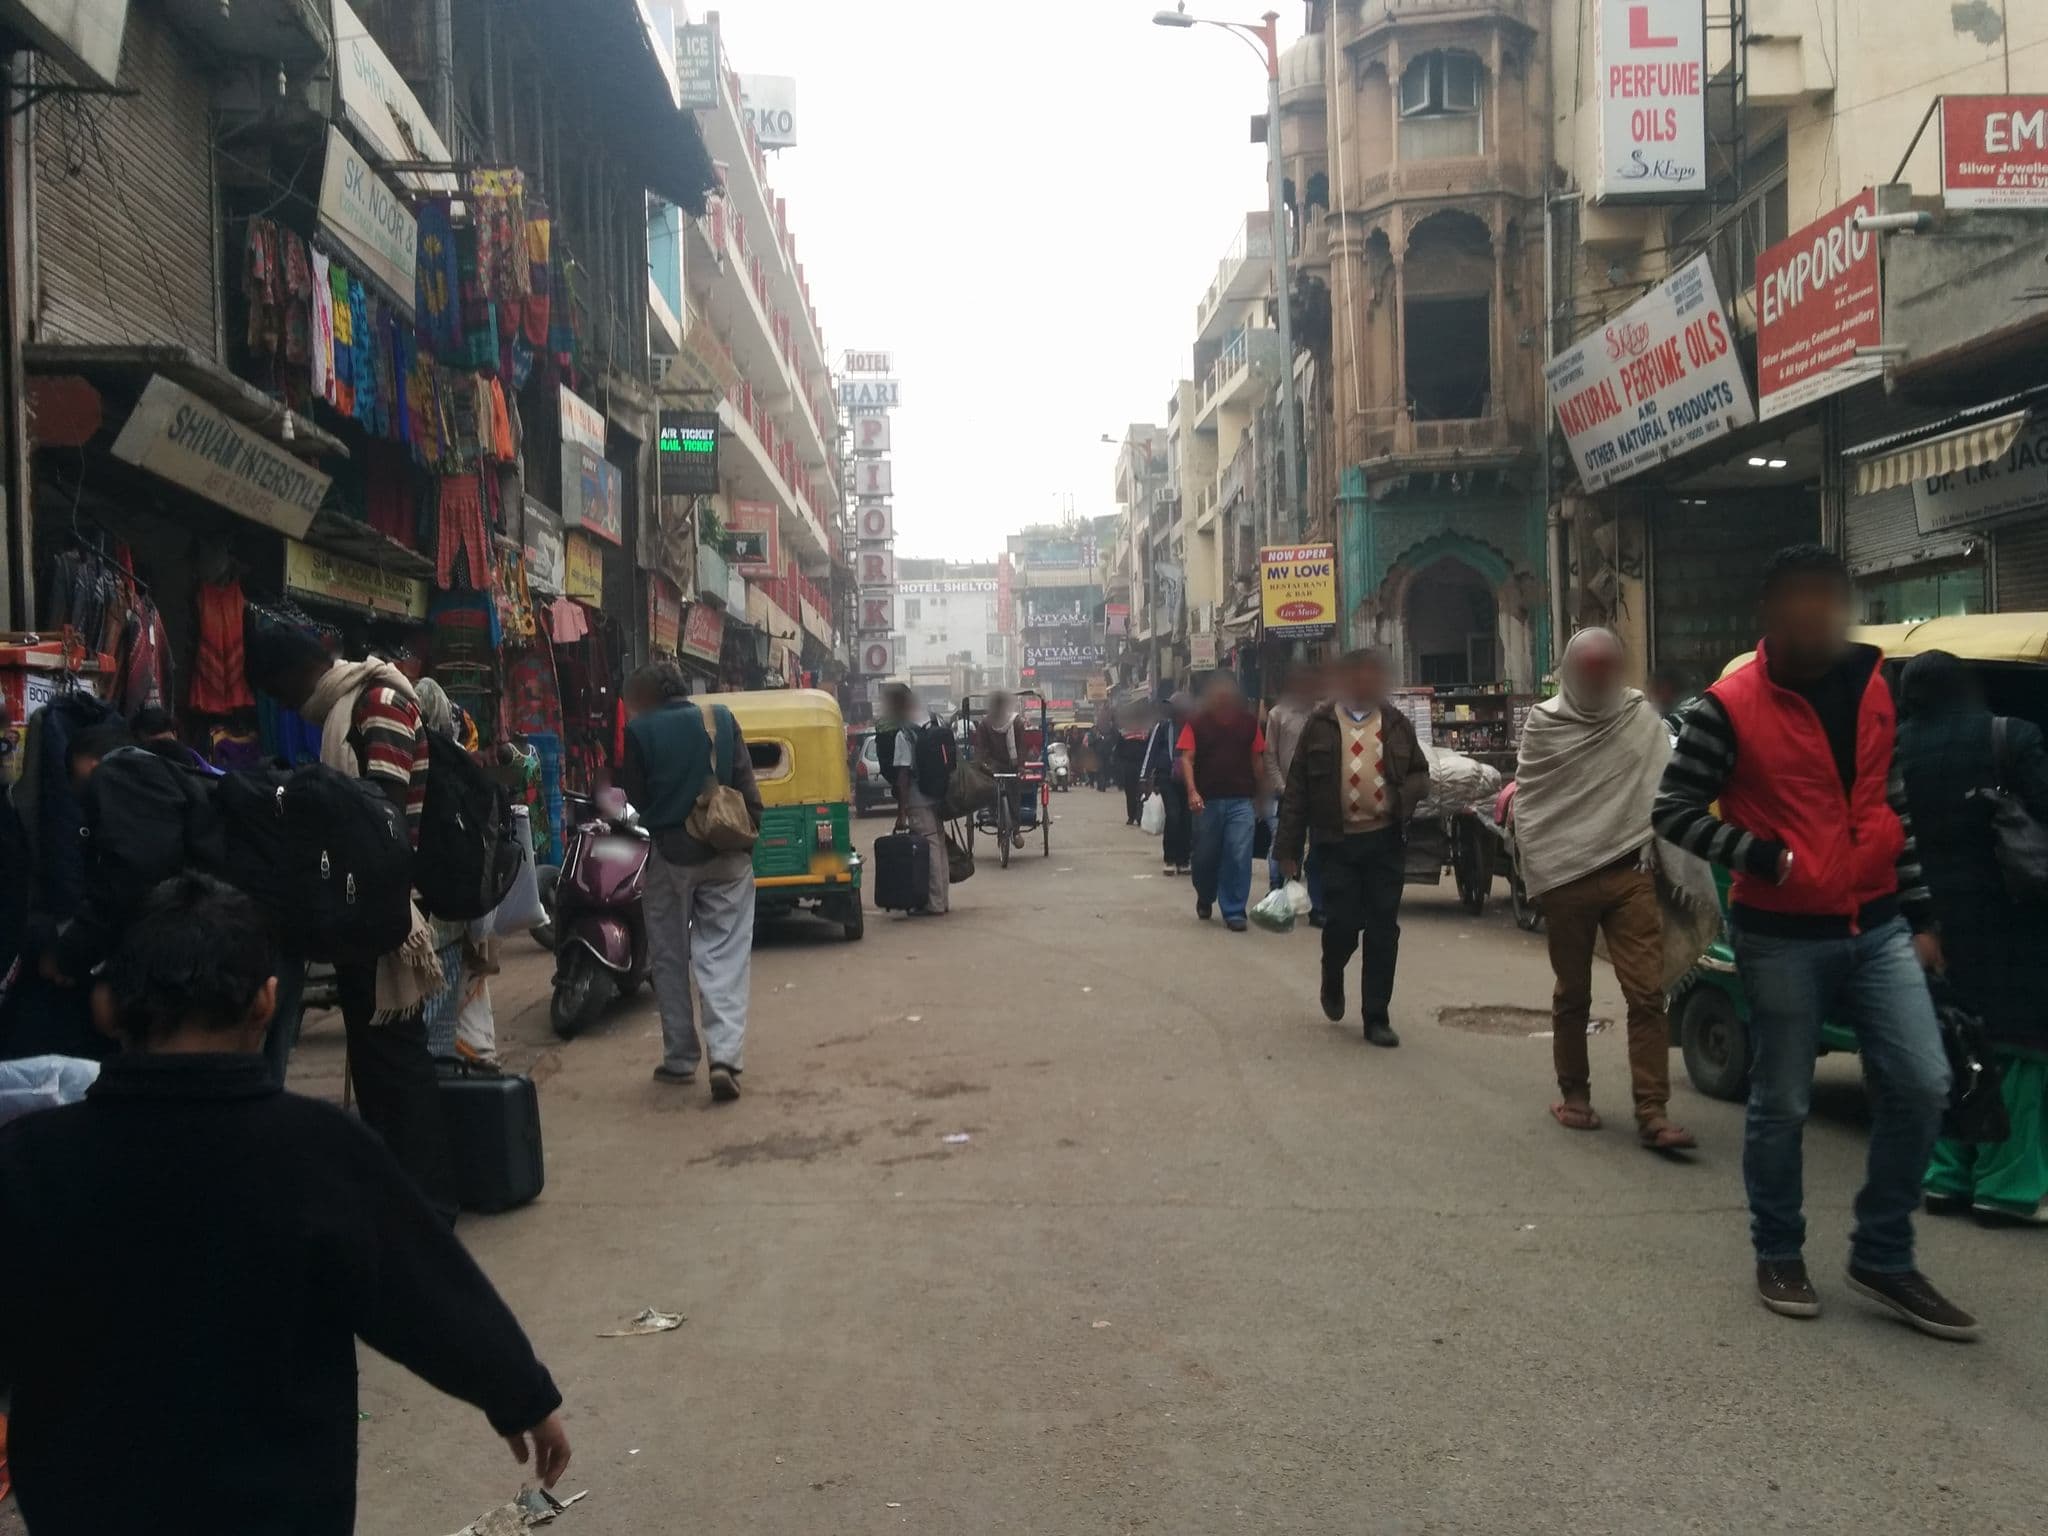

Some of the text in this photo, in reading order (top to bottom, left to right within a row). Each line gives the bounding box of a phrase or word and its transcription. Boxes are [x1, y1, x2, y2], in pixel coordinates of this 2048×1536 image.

[687, 37, 709, 57] ICE
[1609, 62, 1700, 98] PERFUME
[743, 106, 793, 134] RKO
[1631, 108, 1677, 142] OILS
[1959, 163, 1996, 174] Silver
[1997, 175, 2007, 186] &
[2011, 174, 2028, 186] All
[368, 183, 404, 246] NOOR
[405, 224, 414, 257] &
[1763, 204, 1870, 327] EMPORIO
[1812, 324, 1841, 347] Costume
[1841, 306, 1875, 333] Jewellery
[846, 353, 890, 372] HOTEL
[1785, 364, 1794, 379] All
[1817, 337, 1857, 364] Handicrafts
[1558, 310, 1728, 439] NATURAL PERFUME OILS
[841, 382, 899, 403] HARI
[1637, 399, 1658, 422] AND
[661, 427, 715, 440] AIR TICKET
[1584, 441, 1618, 471] OTHER
[1617, 416, 1668, 456] NATURAL
[1667, 380, 1734, 432] PRODUCTS
[167, 405, 244, 470] SHIVAM
[660, 439, 715, 452] RAIL TICKET
[1268, 549, 1327, 561] NOW OPEN
[1267, 563, 1330, 580] MY LOVE
[385, 574, 413, 594] SONS
[900, 581, 999, 593] HOTEL SHELTON
[1269, 581, 1327, 591] RESTAURANT
[1294, 590, 1312, 598] BAR
[1027, 614, 1078, 623] SATYAM
[1281, 608, 1320, 617] Live Music
[1027, 646, 1079, 656] SATYAM
